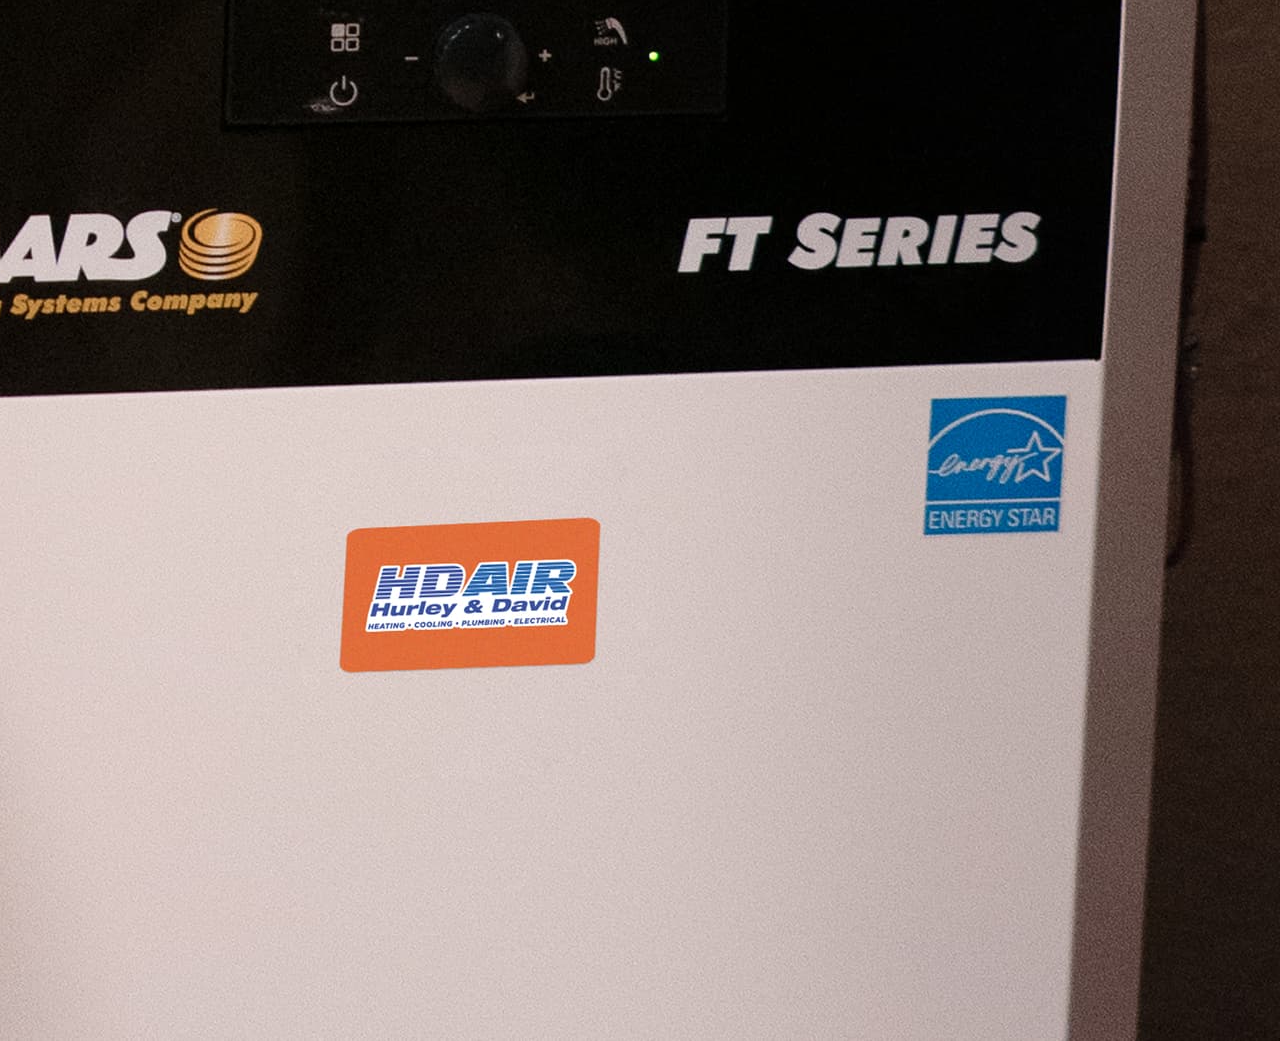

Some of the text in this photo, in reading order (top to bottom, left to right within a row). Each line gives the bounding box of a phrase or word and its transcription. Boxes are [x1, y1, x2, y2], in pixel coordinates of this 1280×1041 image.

[677, 211, 1042, 273] FT SERIES
[9, 291, 121, 320] Systems
[130, 289, 259, 315] Company
[928, 507, 1056, 530] ENERGY STAR
[370, 595, 569, 618] Hurley & David
[367, 616, 567, 630] HEATING COOLING PLUMBING ELECTRICAL
